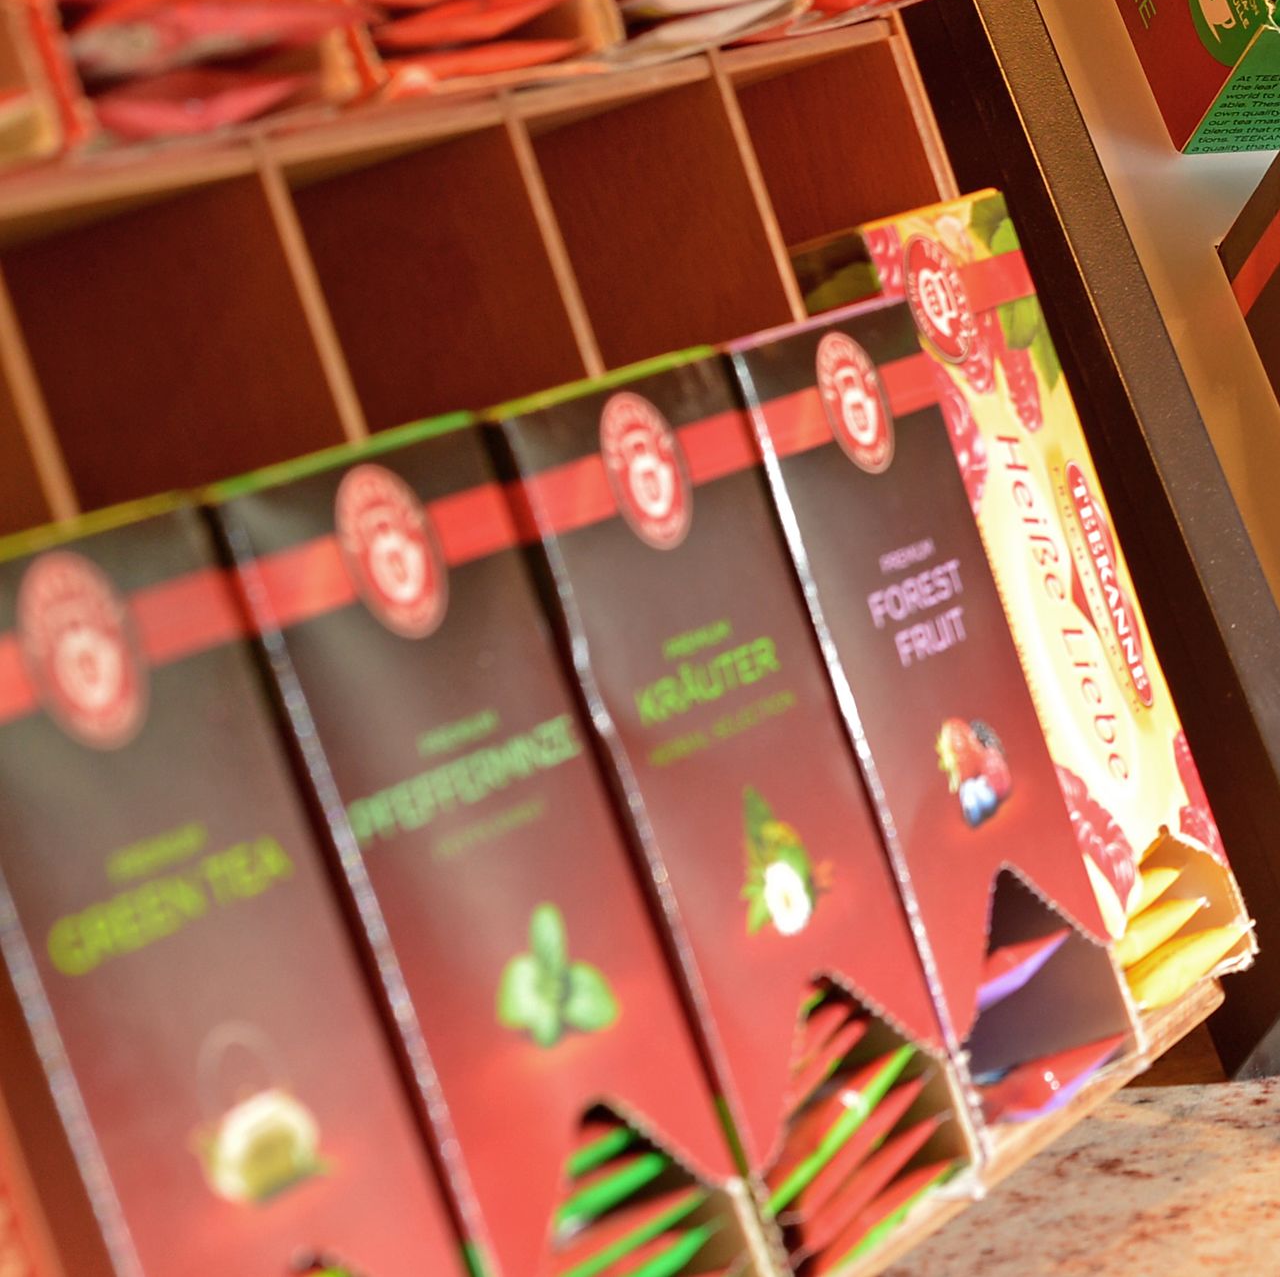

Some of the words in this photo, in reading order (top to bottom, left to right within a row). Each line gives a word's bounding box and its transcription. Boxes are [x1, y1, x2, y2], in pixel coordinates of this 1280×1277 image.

[1253, 82, 1278, 90] leaf
[868, 561, 964, 630] FOREST
[995, 433, 1068, 602] Heiße
[1062, 625, 1131, 784] Liebe
[1073, 476, 1149, 692] TEEKANNE
[895, 607, 967, 667] FRUIT
[634, 637, 781, 726] KRÄUTER
